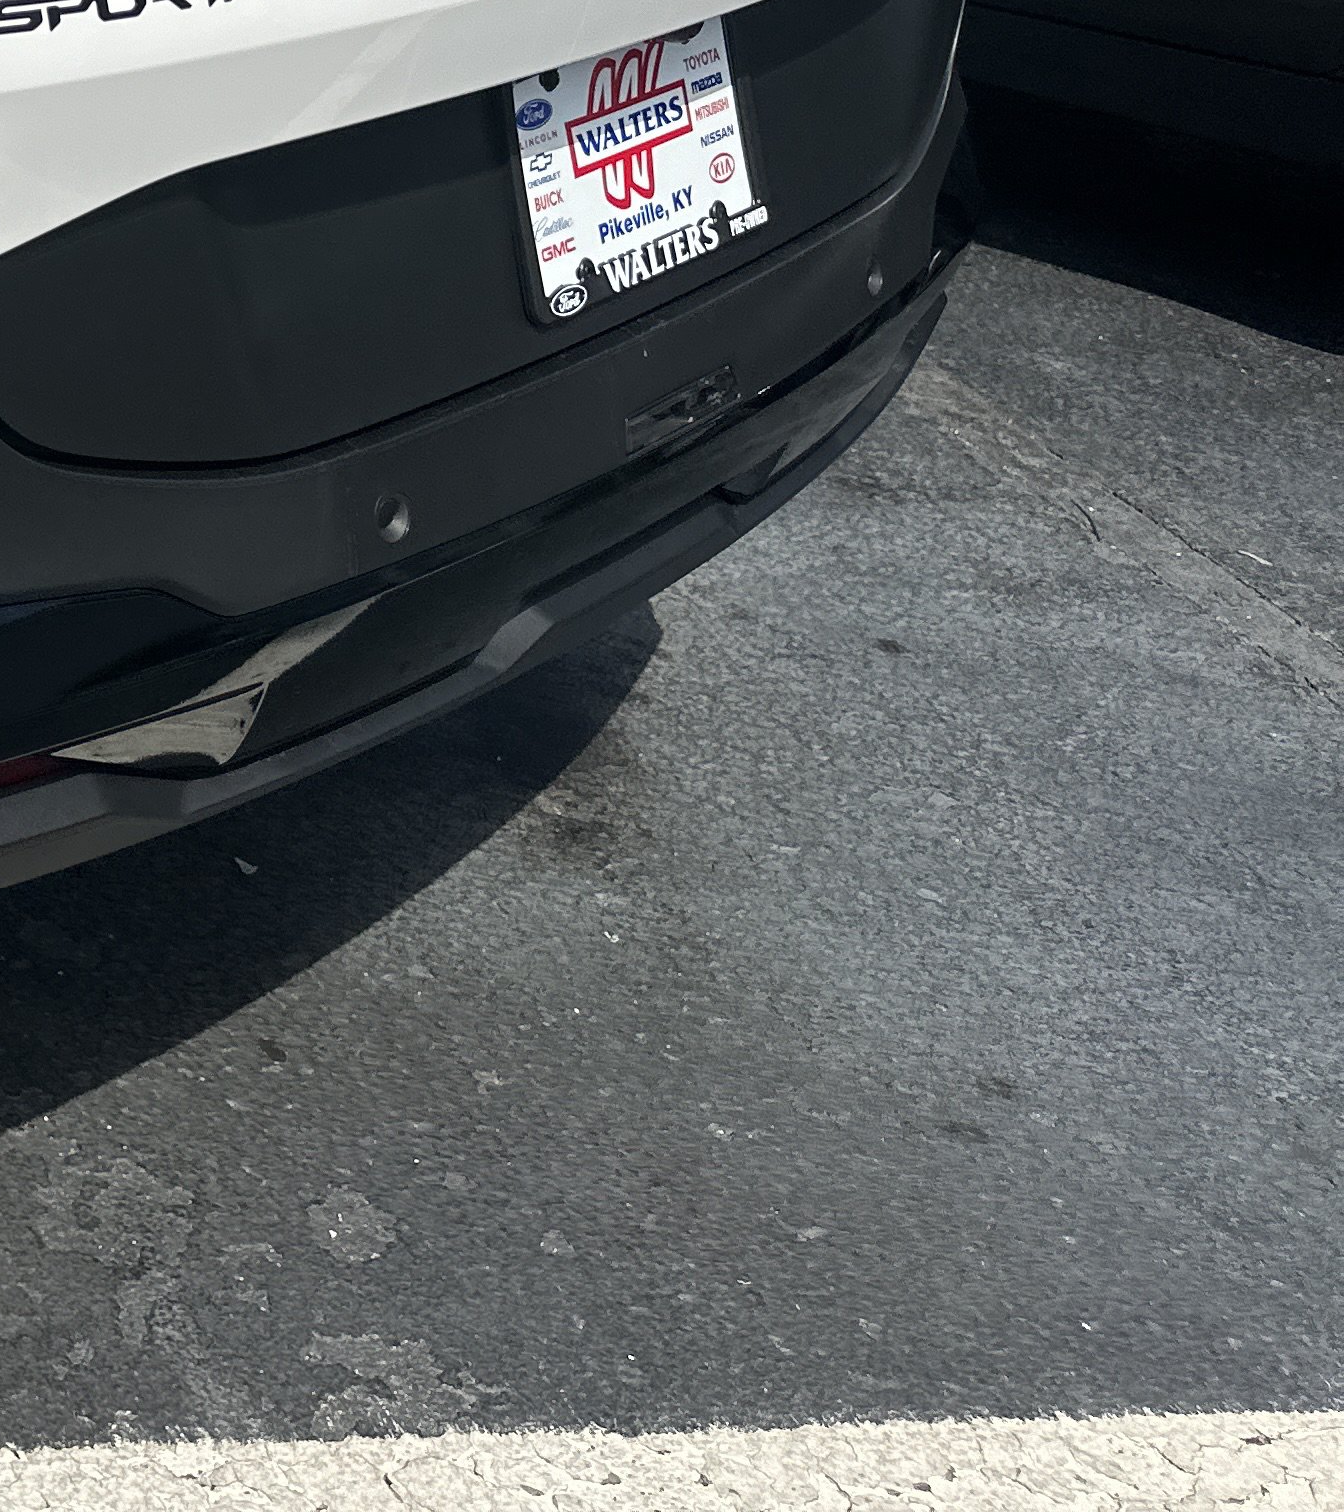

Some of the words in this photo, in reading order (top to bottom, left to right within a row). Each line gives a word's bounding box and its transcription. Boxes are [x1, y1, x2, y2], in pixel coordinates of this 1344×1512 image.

[683, 47, 721, 72] TOYOTA
[575, 95, 684, 156] WALTERS
[700, 124, 735, 148] NISSAN
[519, 129, 558, 150] LINCOLN
[534, 189, 564, 212] BUICK
[598, 202, 670, 244] Pikeville,
[671, 185, 694, 213] KY
[541, 237, 577, 263] GMC
[603, 218, 719, 293] WALTERS
